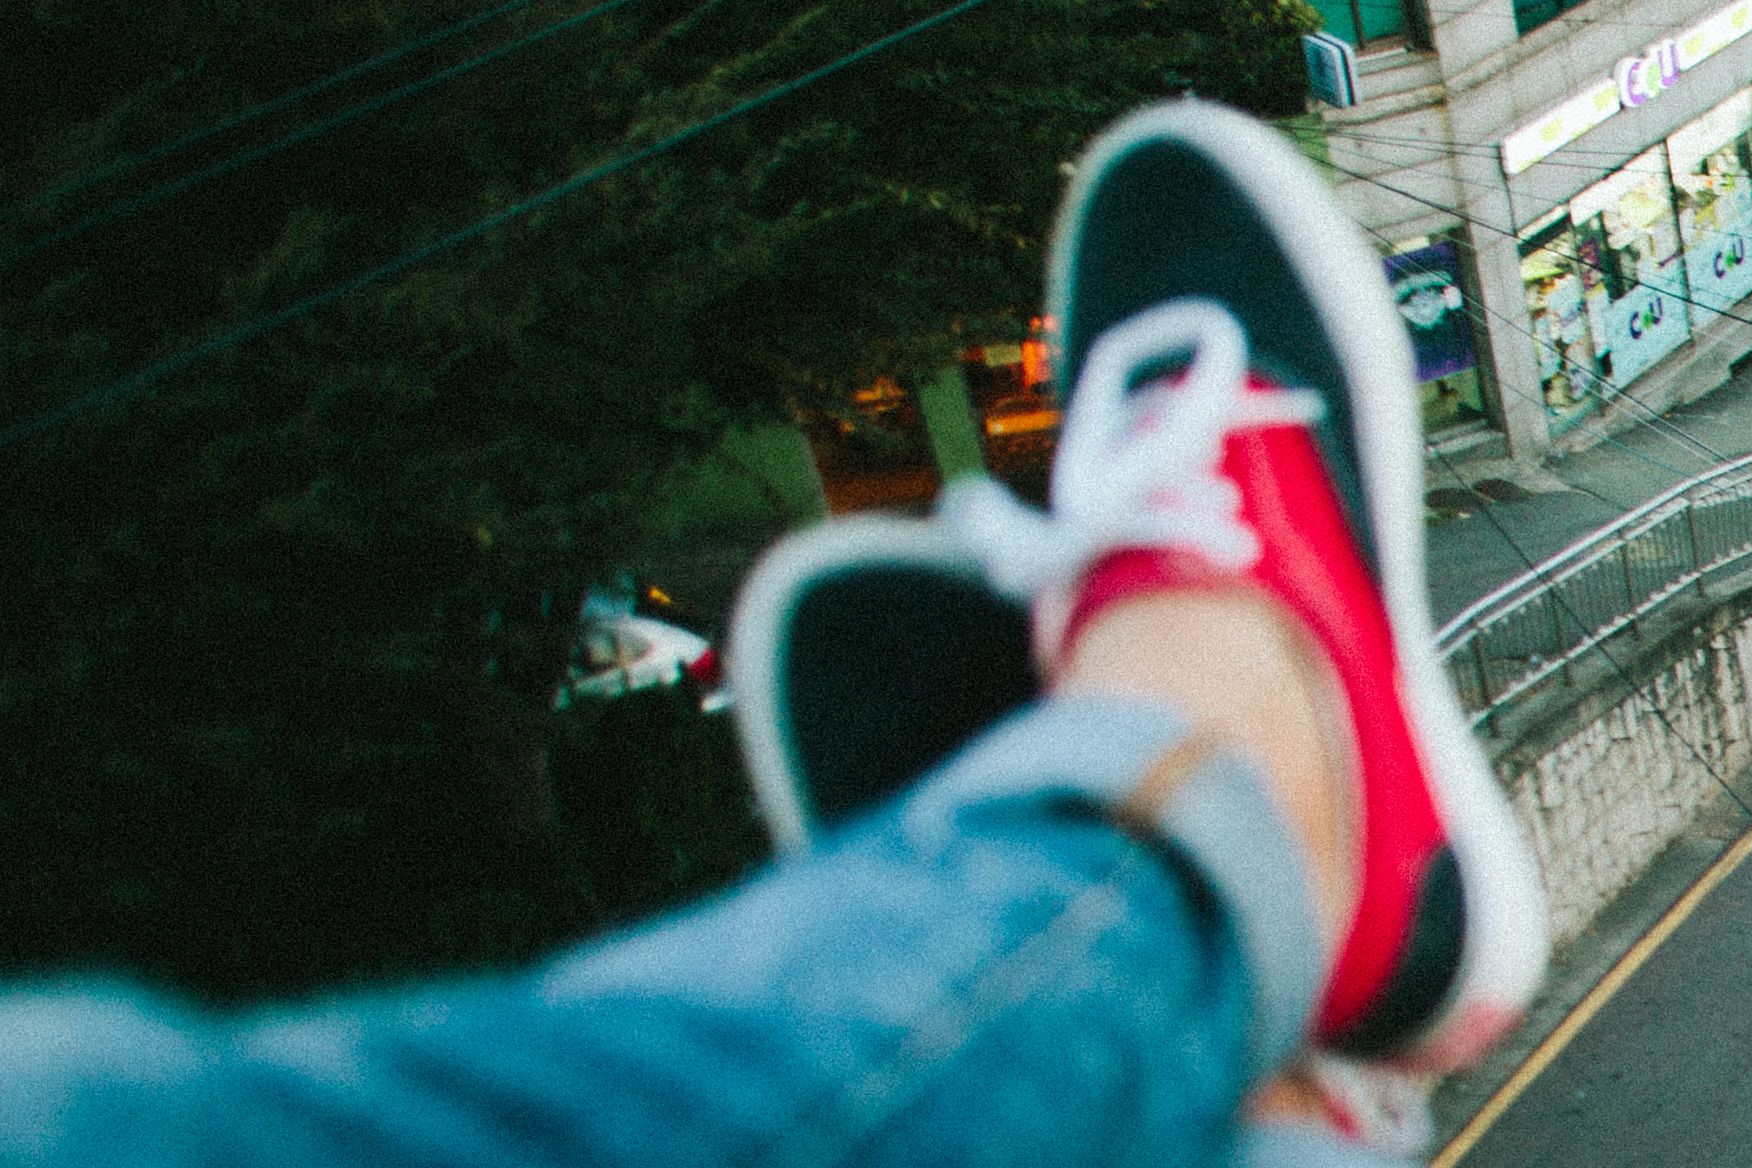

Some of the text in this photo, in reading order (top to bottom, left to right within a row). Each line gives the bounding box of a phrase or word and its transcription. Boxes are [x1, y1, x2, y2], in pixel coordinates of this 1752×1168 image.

[1625, 42, 1679, 105] CU
[1714, 235, 1746, 279] CU
[1629, 295, 1664, 340] CU
